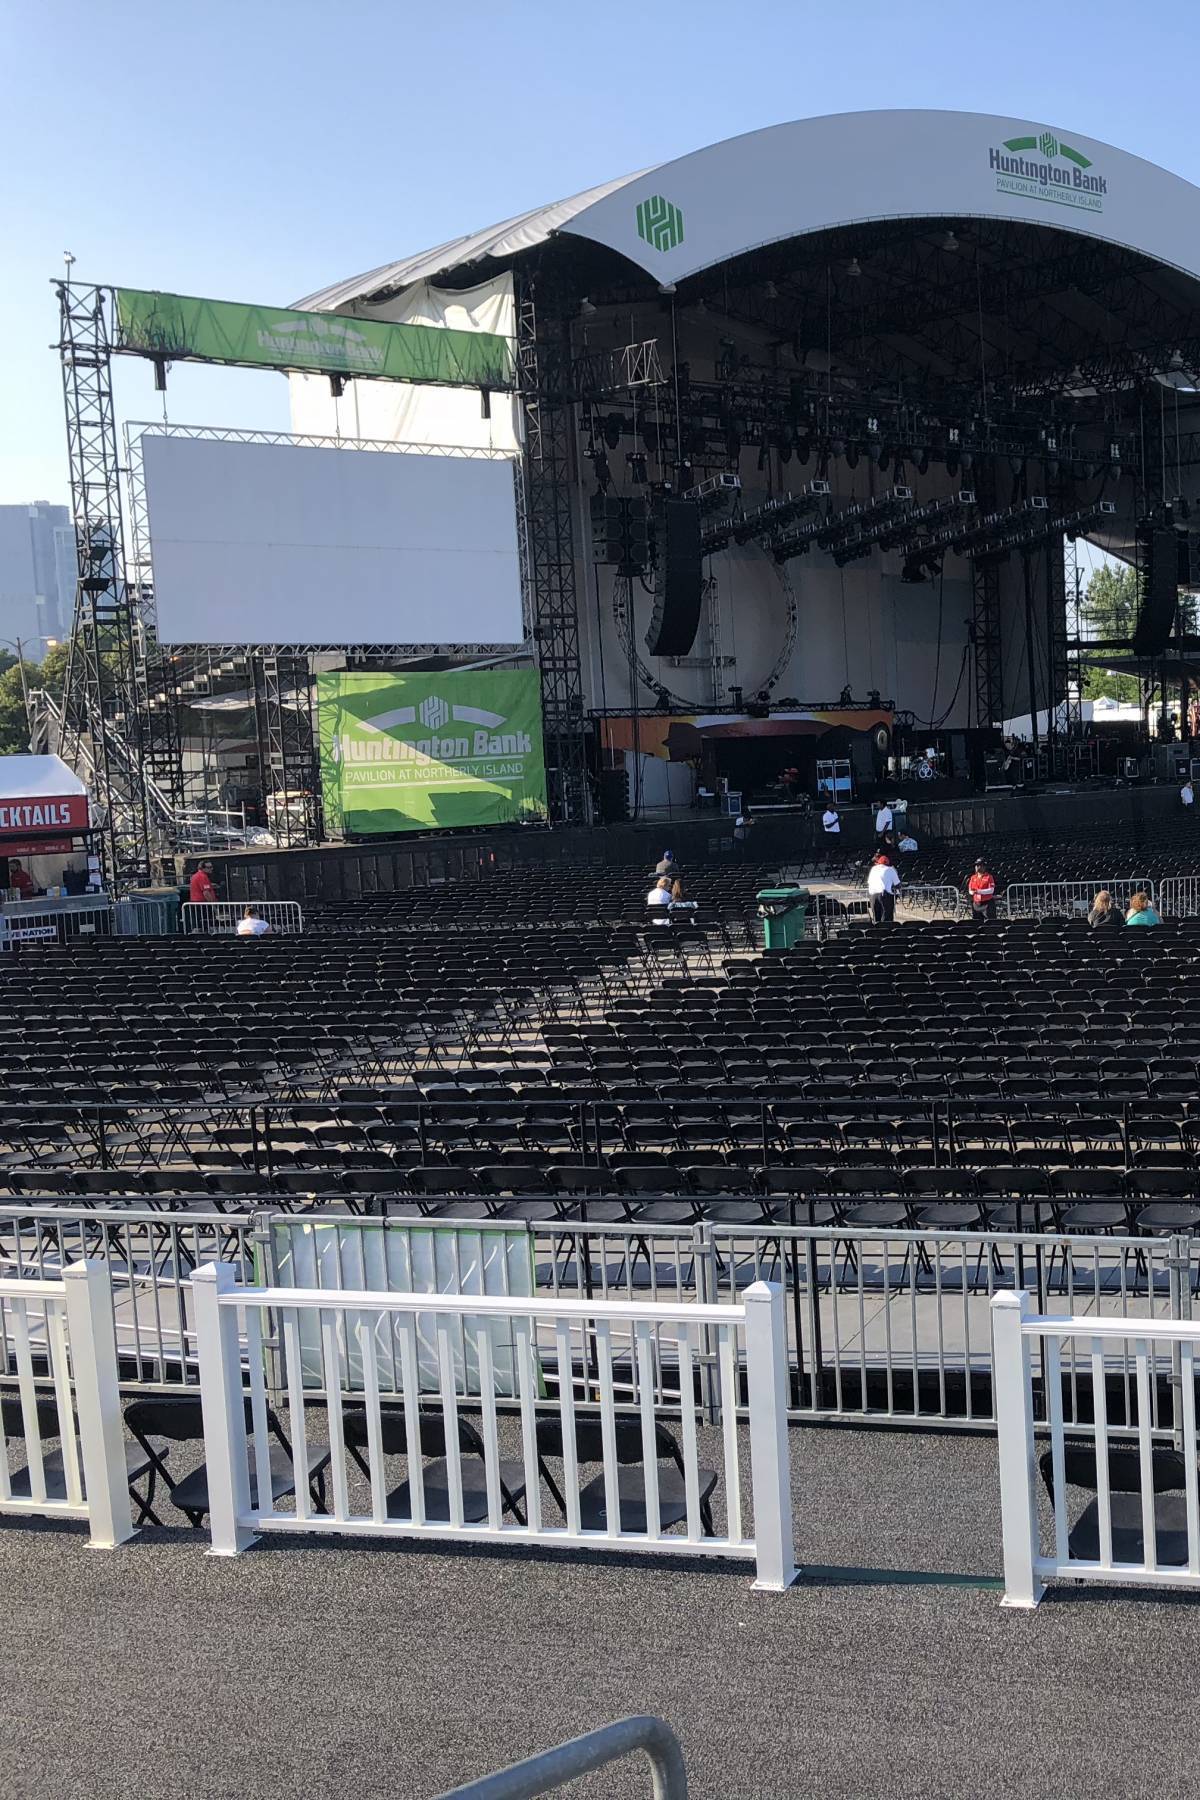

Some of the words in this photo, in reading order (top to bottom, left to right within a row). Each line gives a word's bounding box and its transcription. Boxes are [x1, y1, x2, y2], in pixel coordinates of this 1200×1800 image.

[989, 148, 1070, 185] Huntington
[1073, 167, 1107, 194] Bank
[996, 178, 1028, 192] PAVILION
[1029, 185, 1037, 194] AT
[1038, 188, 1078, 203] NORTHERLY
[1079, 195, 1102, 208] ISLAND
[333, 734, 469, 766] Huntington
[472, 730, 532, 756] Bank
[345, 769, 396, 783] PAVILION
[399, 768, 411, 780] AT
[414, 765, 479, 779] NORTHERLY
[482, 762, 524, 776] ISLAND
[22, 927, 54, 937] NATION
